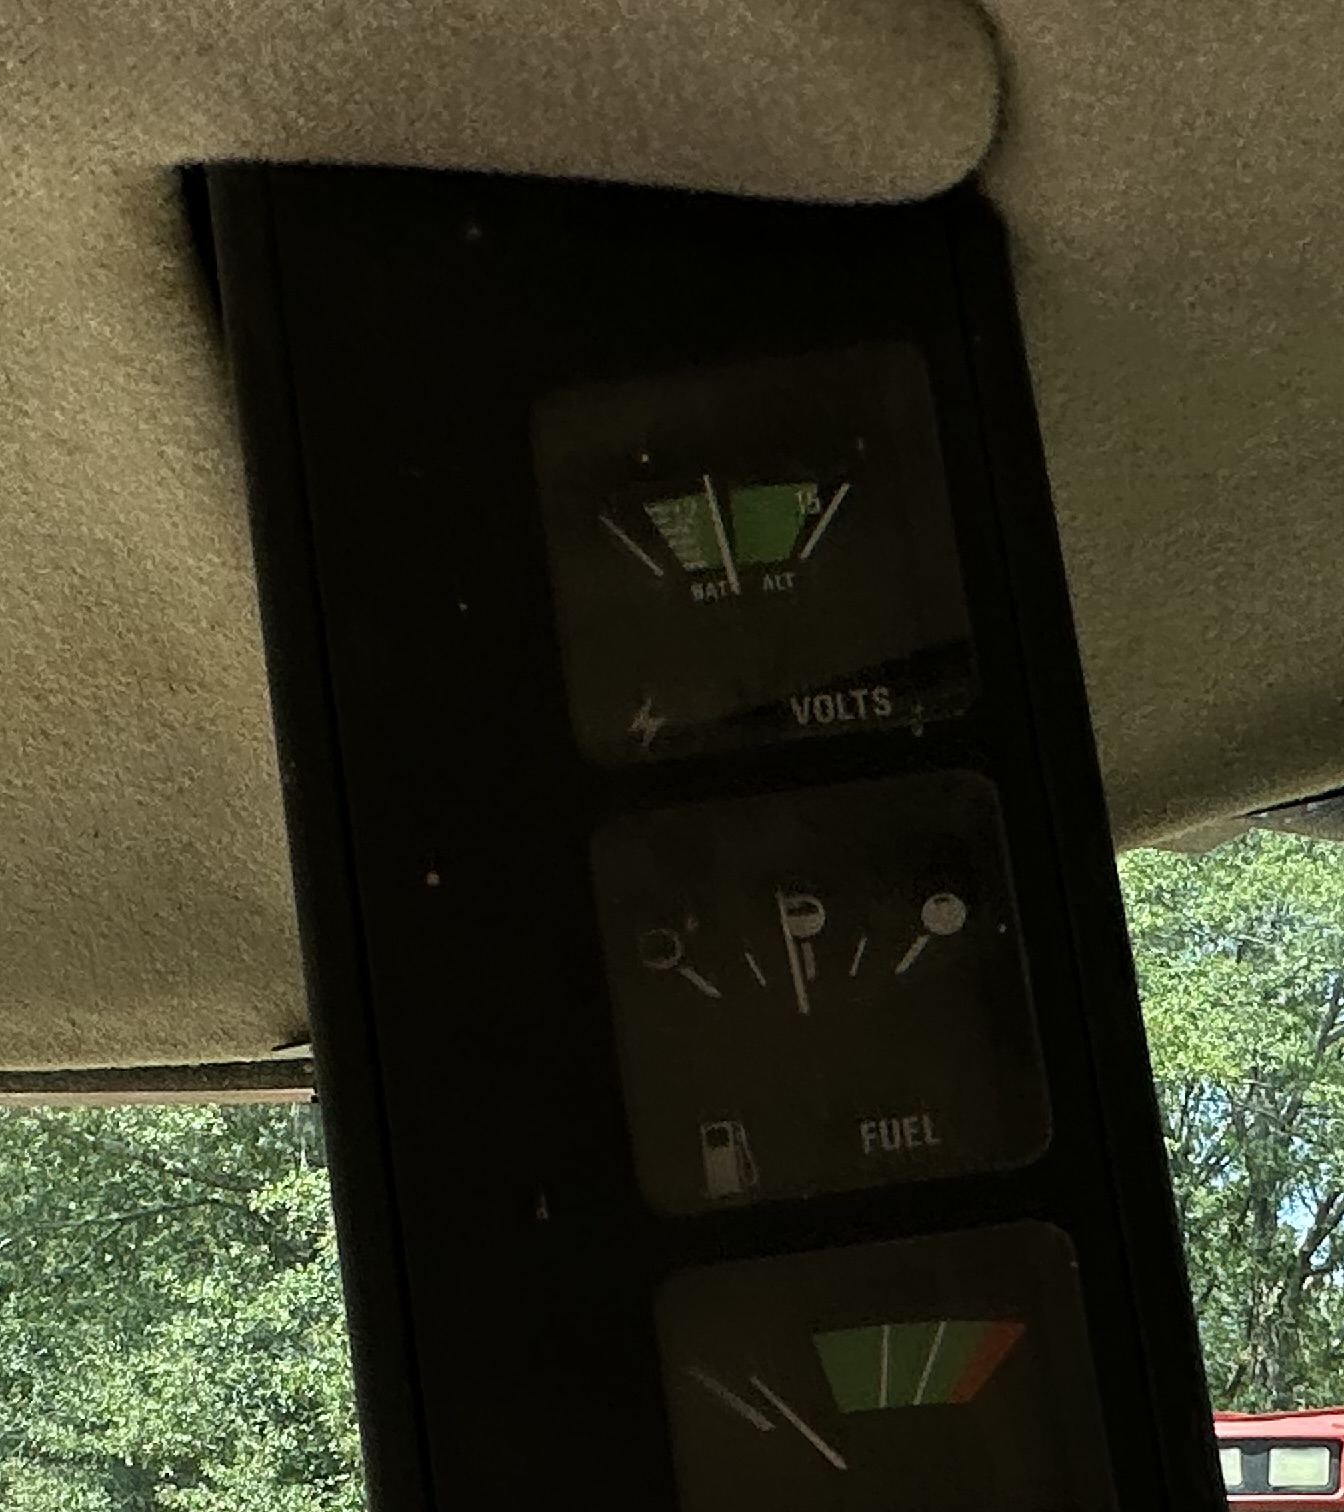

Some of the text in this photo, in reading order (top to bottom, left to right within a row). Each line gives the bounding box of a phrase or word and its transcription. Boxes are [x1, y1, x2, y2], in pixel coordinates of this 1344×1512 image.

[763, 573, 796, 592] ALT
[789, 686, 893, 727] VOLTS
[859, 1115, 941, 1155] FUEL
